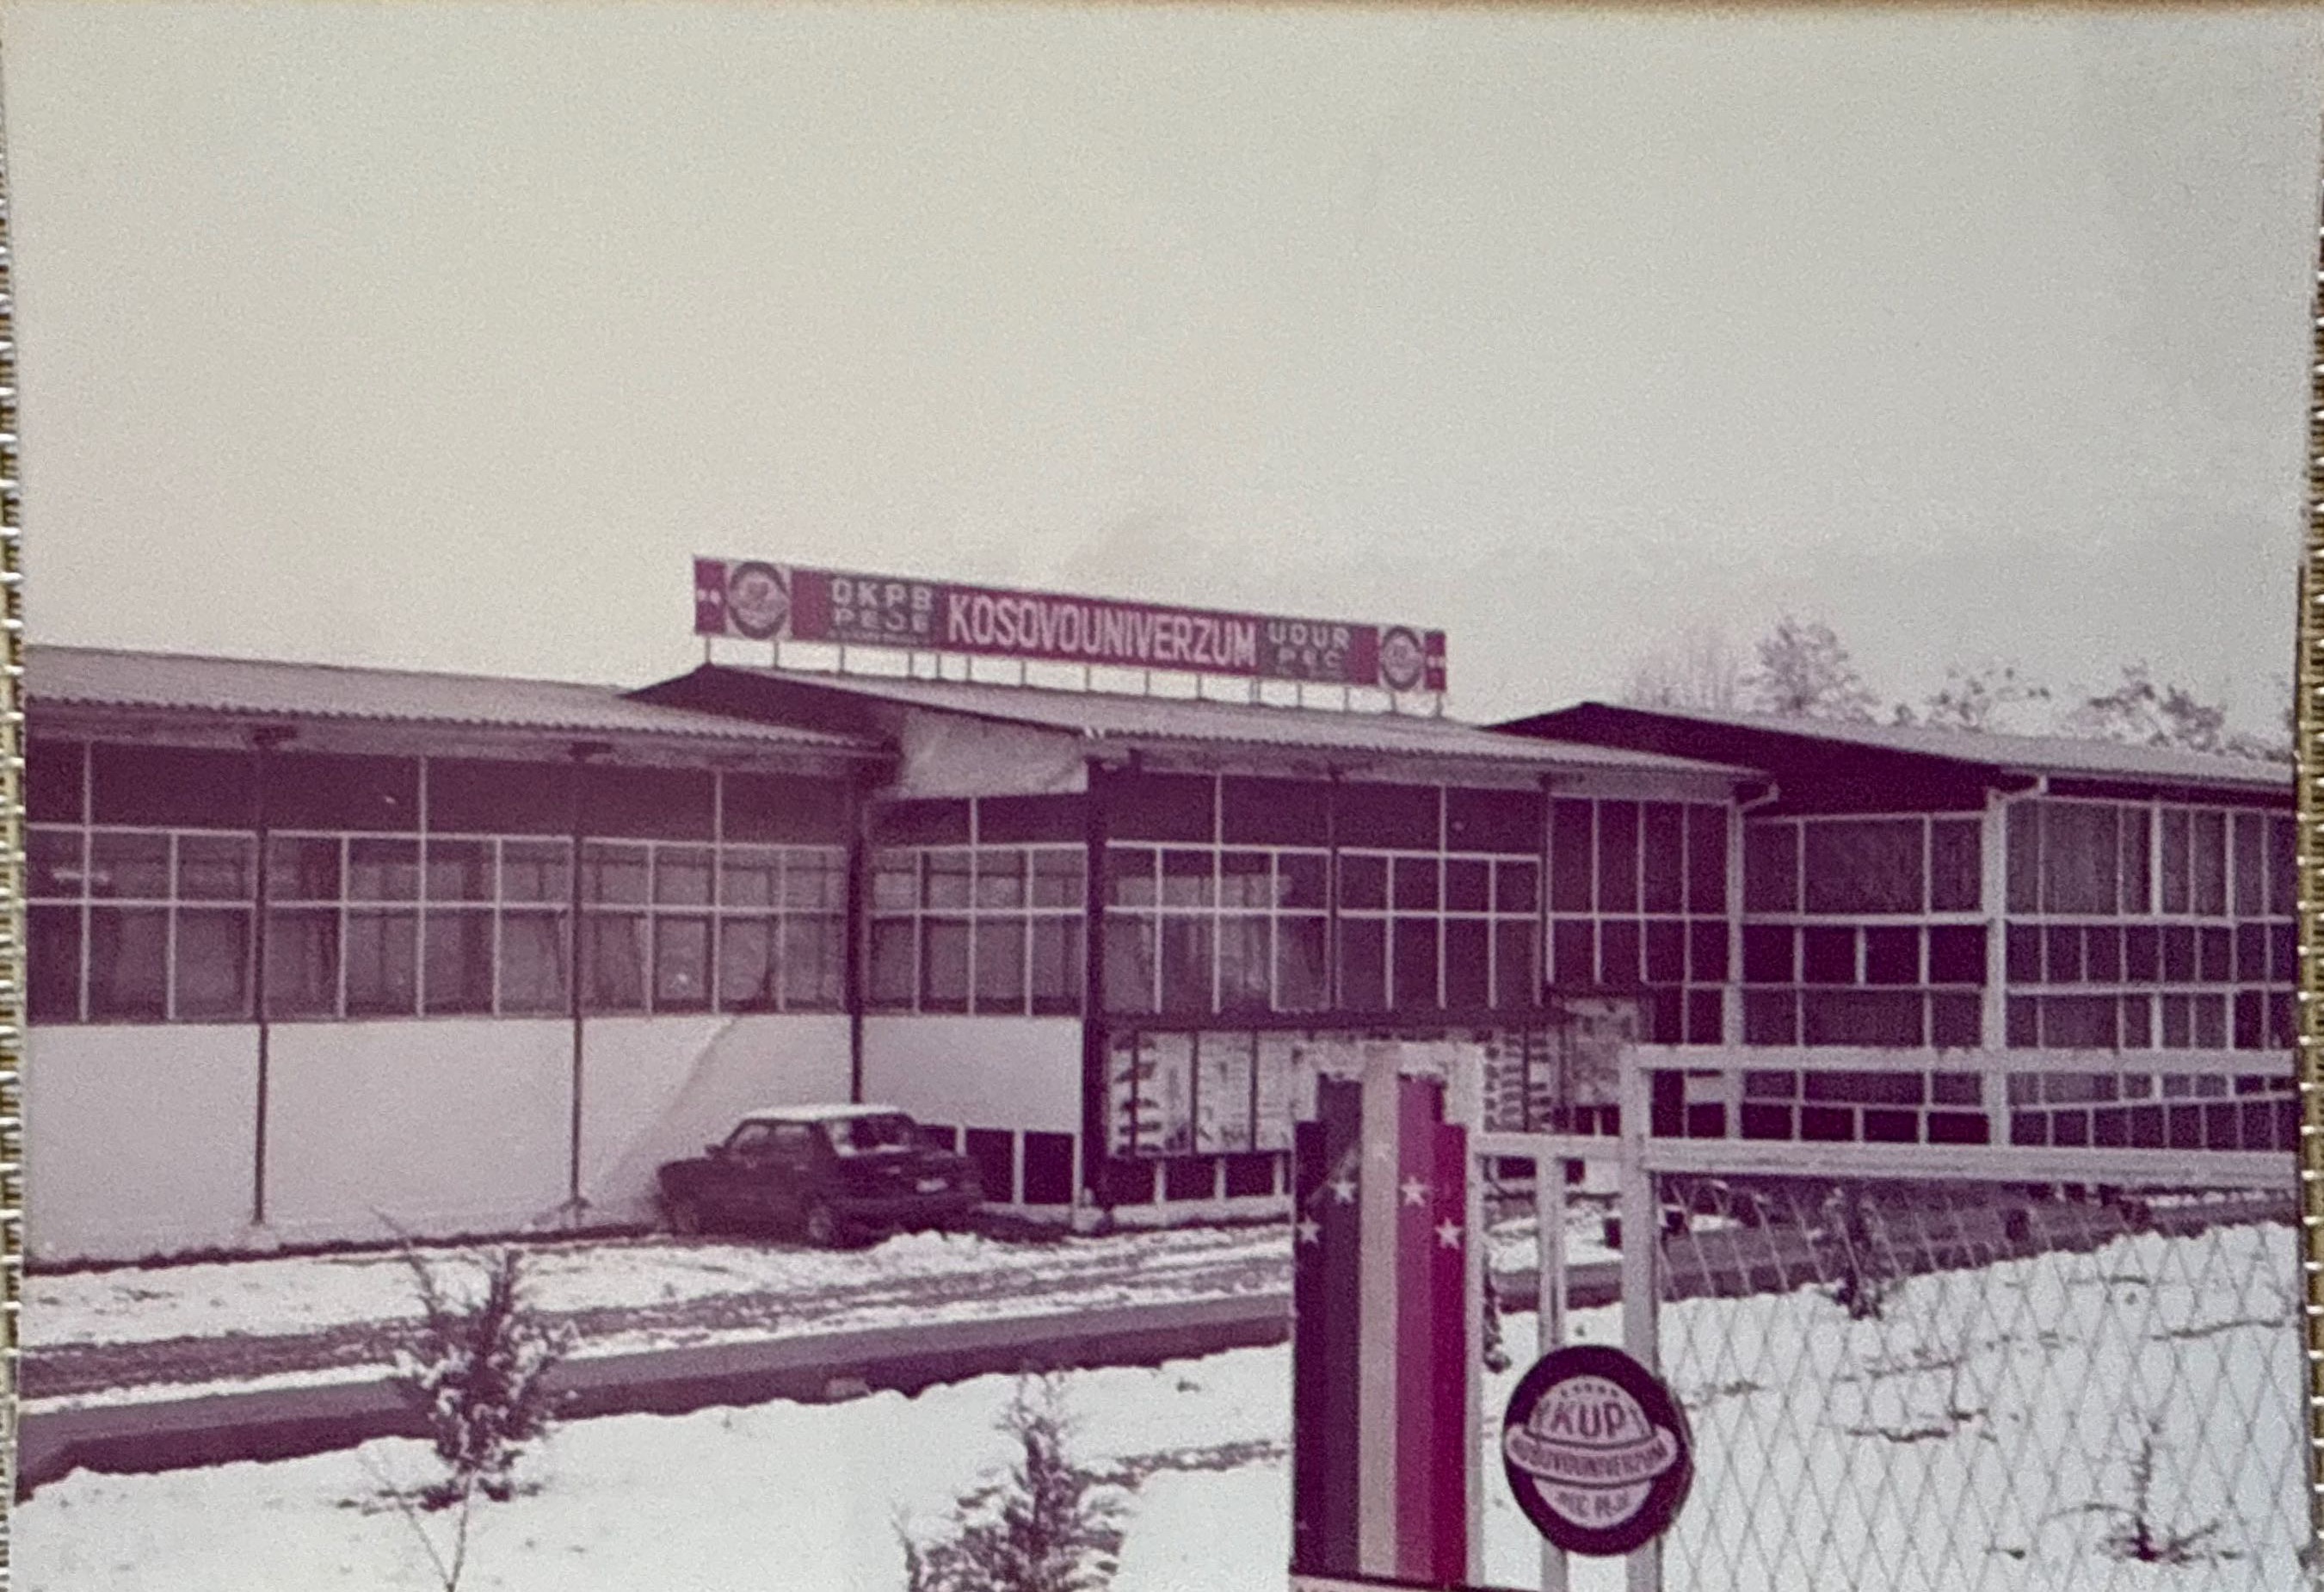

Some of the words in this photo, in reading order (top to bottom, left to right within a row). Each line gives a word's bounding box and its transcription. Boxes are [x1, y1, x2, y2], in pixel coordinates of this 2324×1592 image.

[948, 593, 1257, 669] KOSOVOUNIVERZUM
[1267, 621, 1350, 651] UOUR
[1551, 1401, 1626, 1438] KUP
